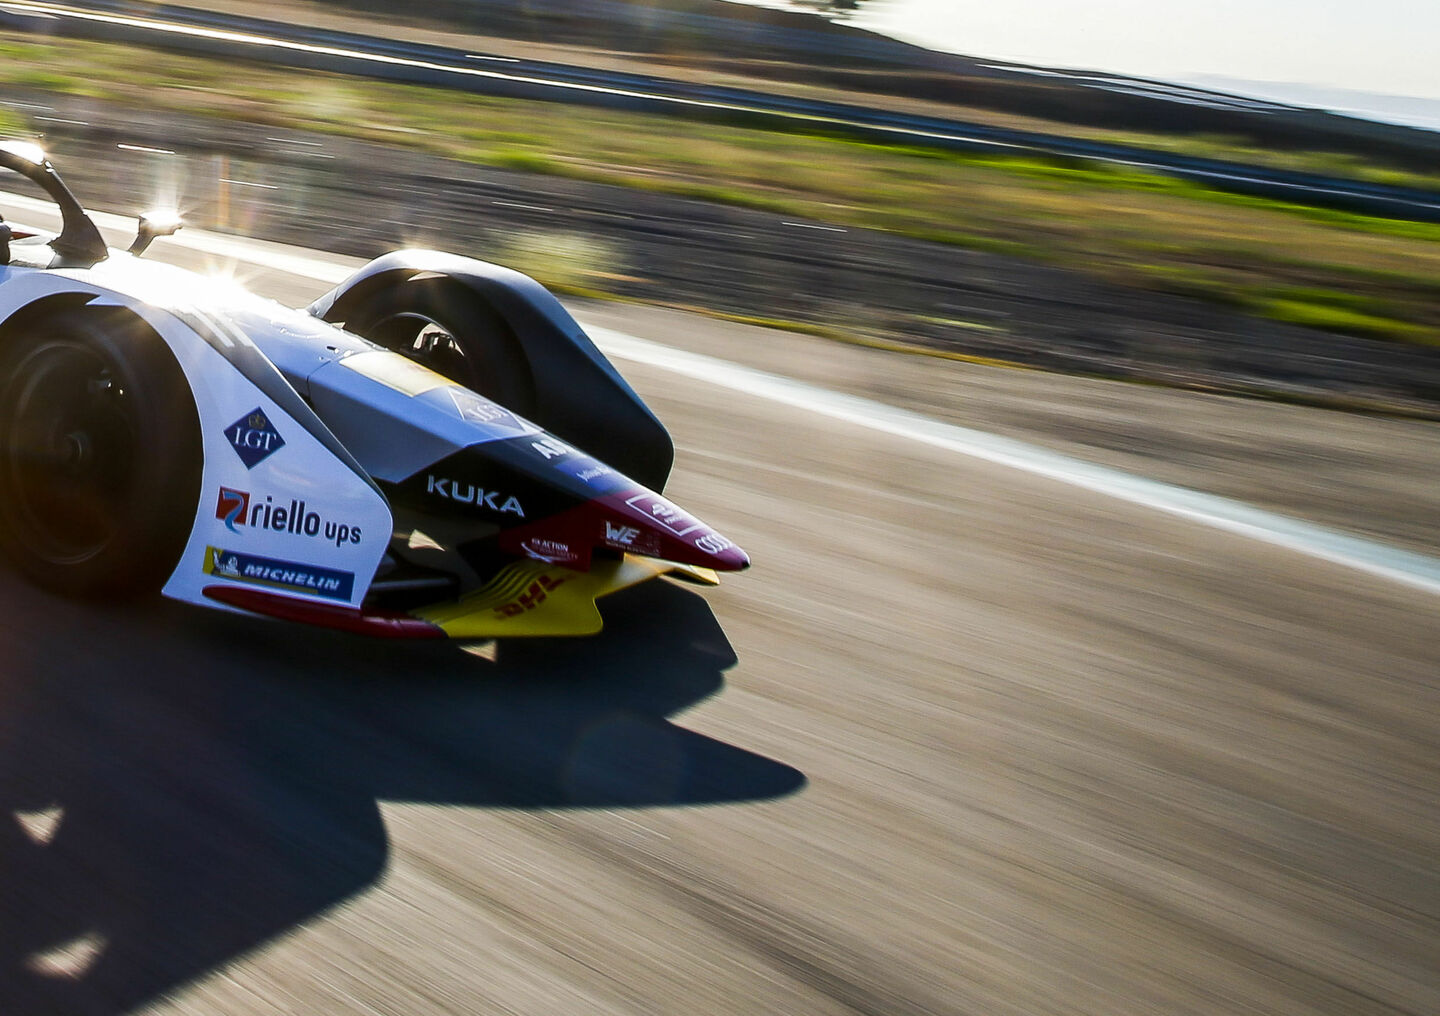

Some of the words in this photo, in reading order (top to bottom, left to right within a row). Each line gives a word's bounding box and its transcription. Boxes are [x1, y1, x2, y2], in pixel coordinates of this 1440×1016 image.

[234, 427, 277, 451] LGT
[427, 474, 526, 518] KUKA
[250, 495, 321, 537] riello
[324, 521, 362, 548] ups
[244, 562, 341, 592] MICHELIN
[492, 574, 568, 619] DHL
